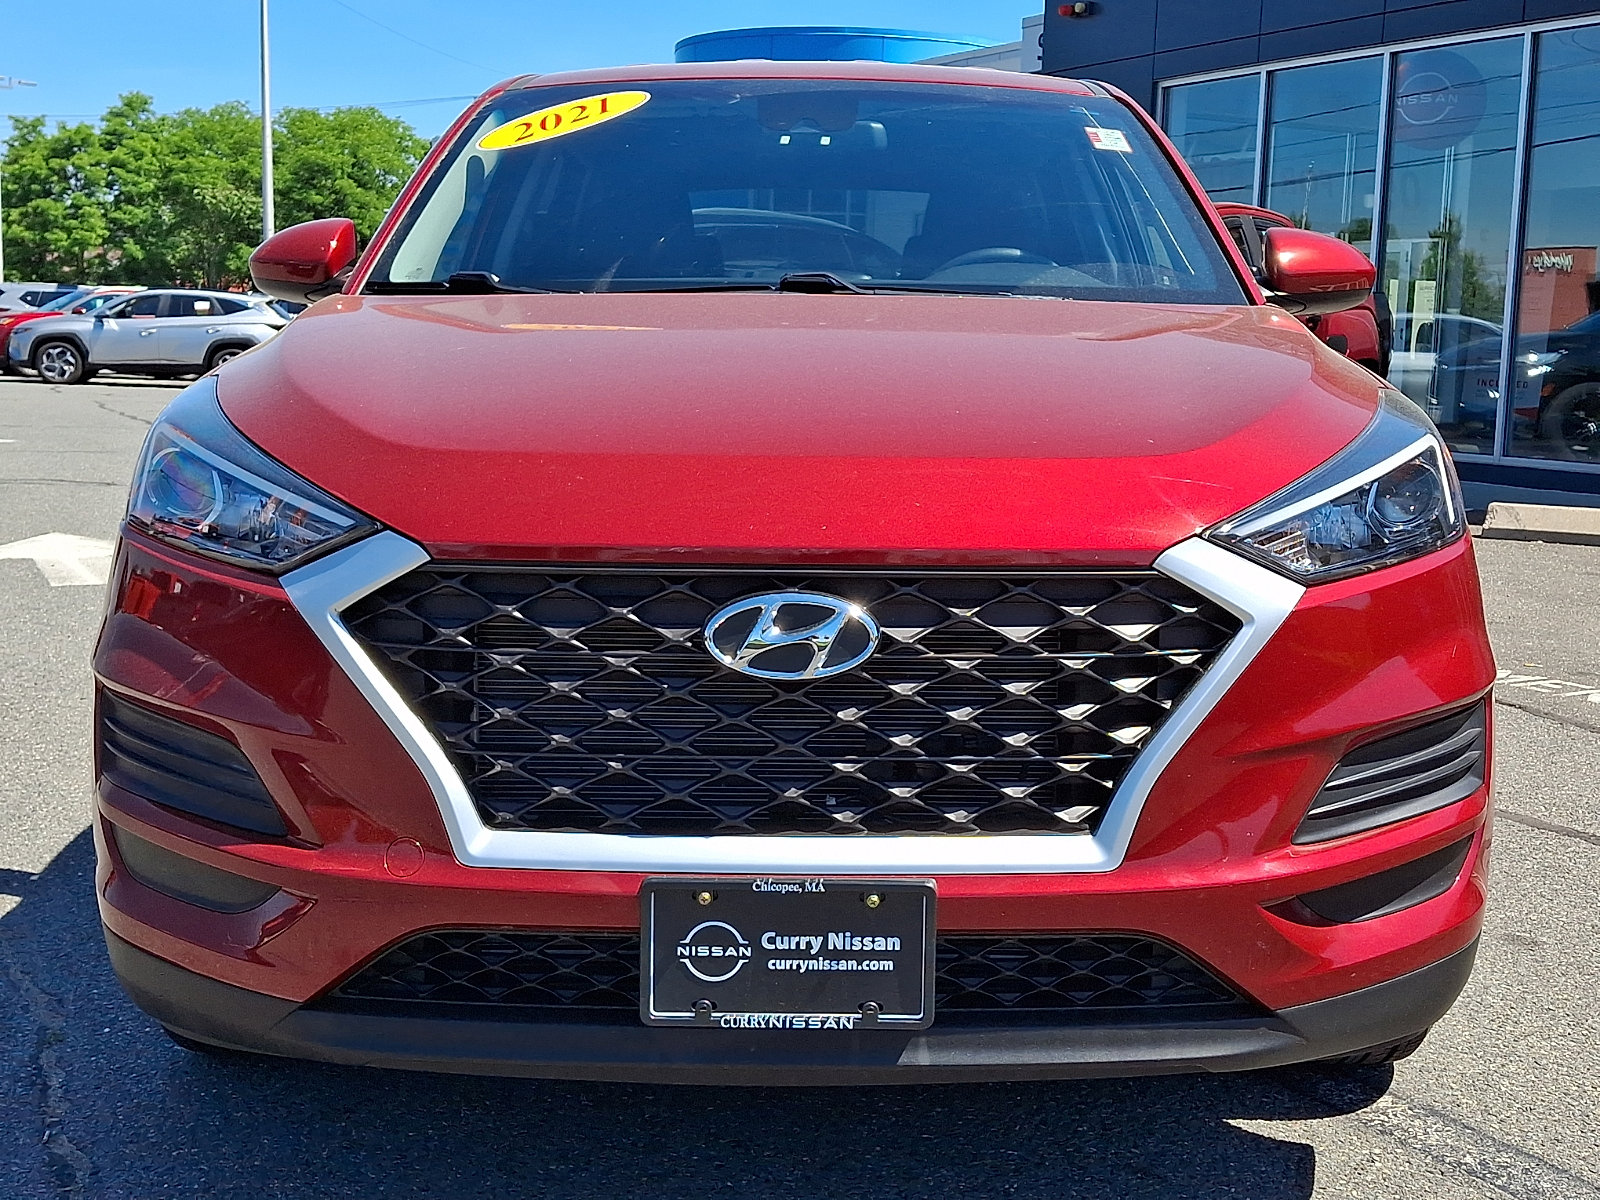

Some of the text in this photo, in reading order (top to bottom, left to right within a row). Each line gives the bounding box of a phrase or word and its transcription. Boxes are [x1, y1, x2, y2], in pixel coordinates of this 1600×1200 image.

[1395, 93, 1458, 105] NISSAN
[514, 98, 609, 142] 2021
[752, 879, 825, 893] Chicopee, MA
[761, 931, 901, 953] Curry Nissan
[677, 946, 752, 957] NISSAN
[767, 957, 894, 973] currynissan.com
